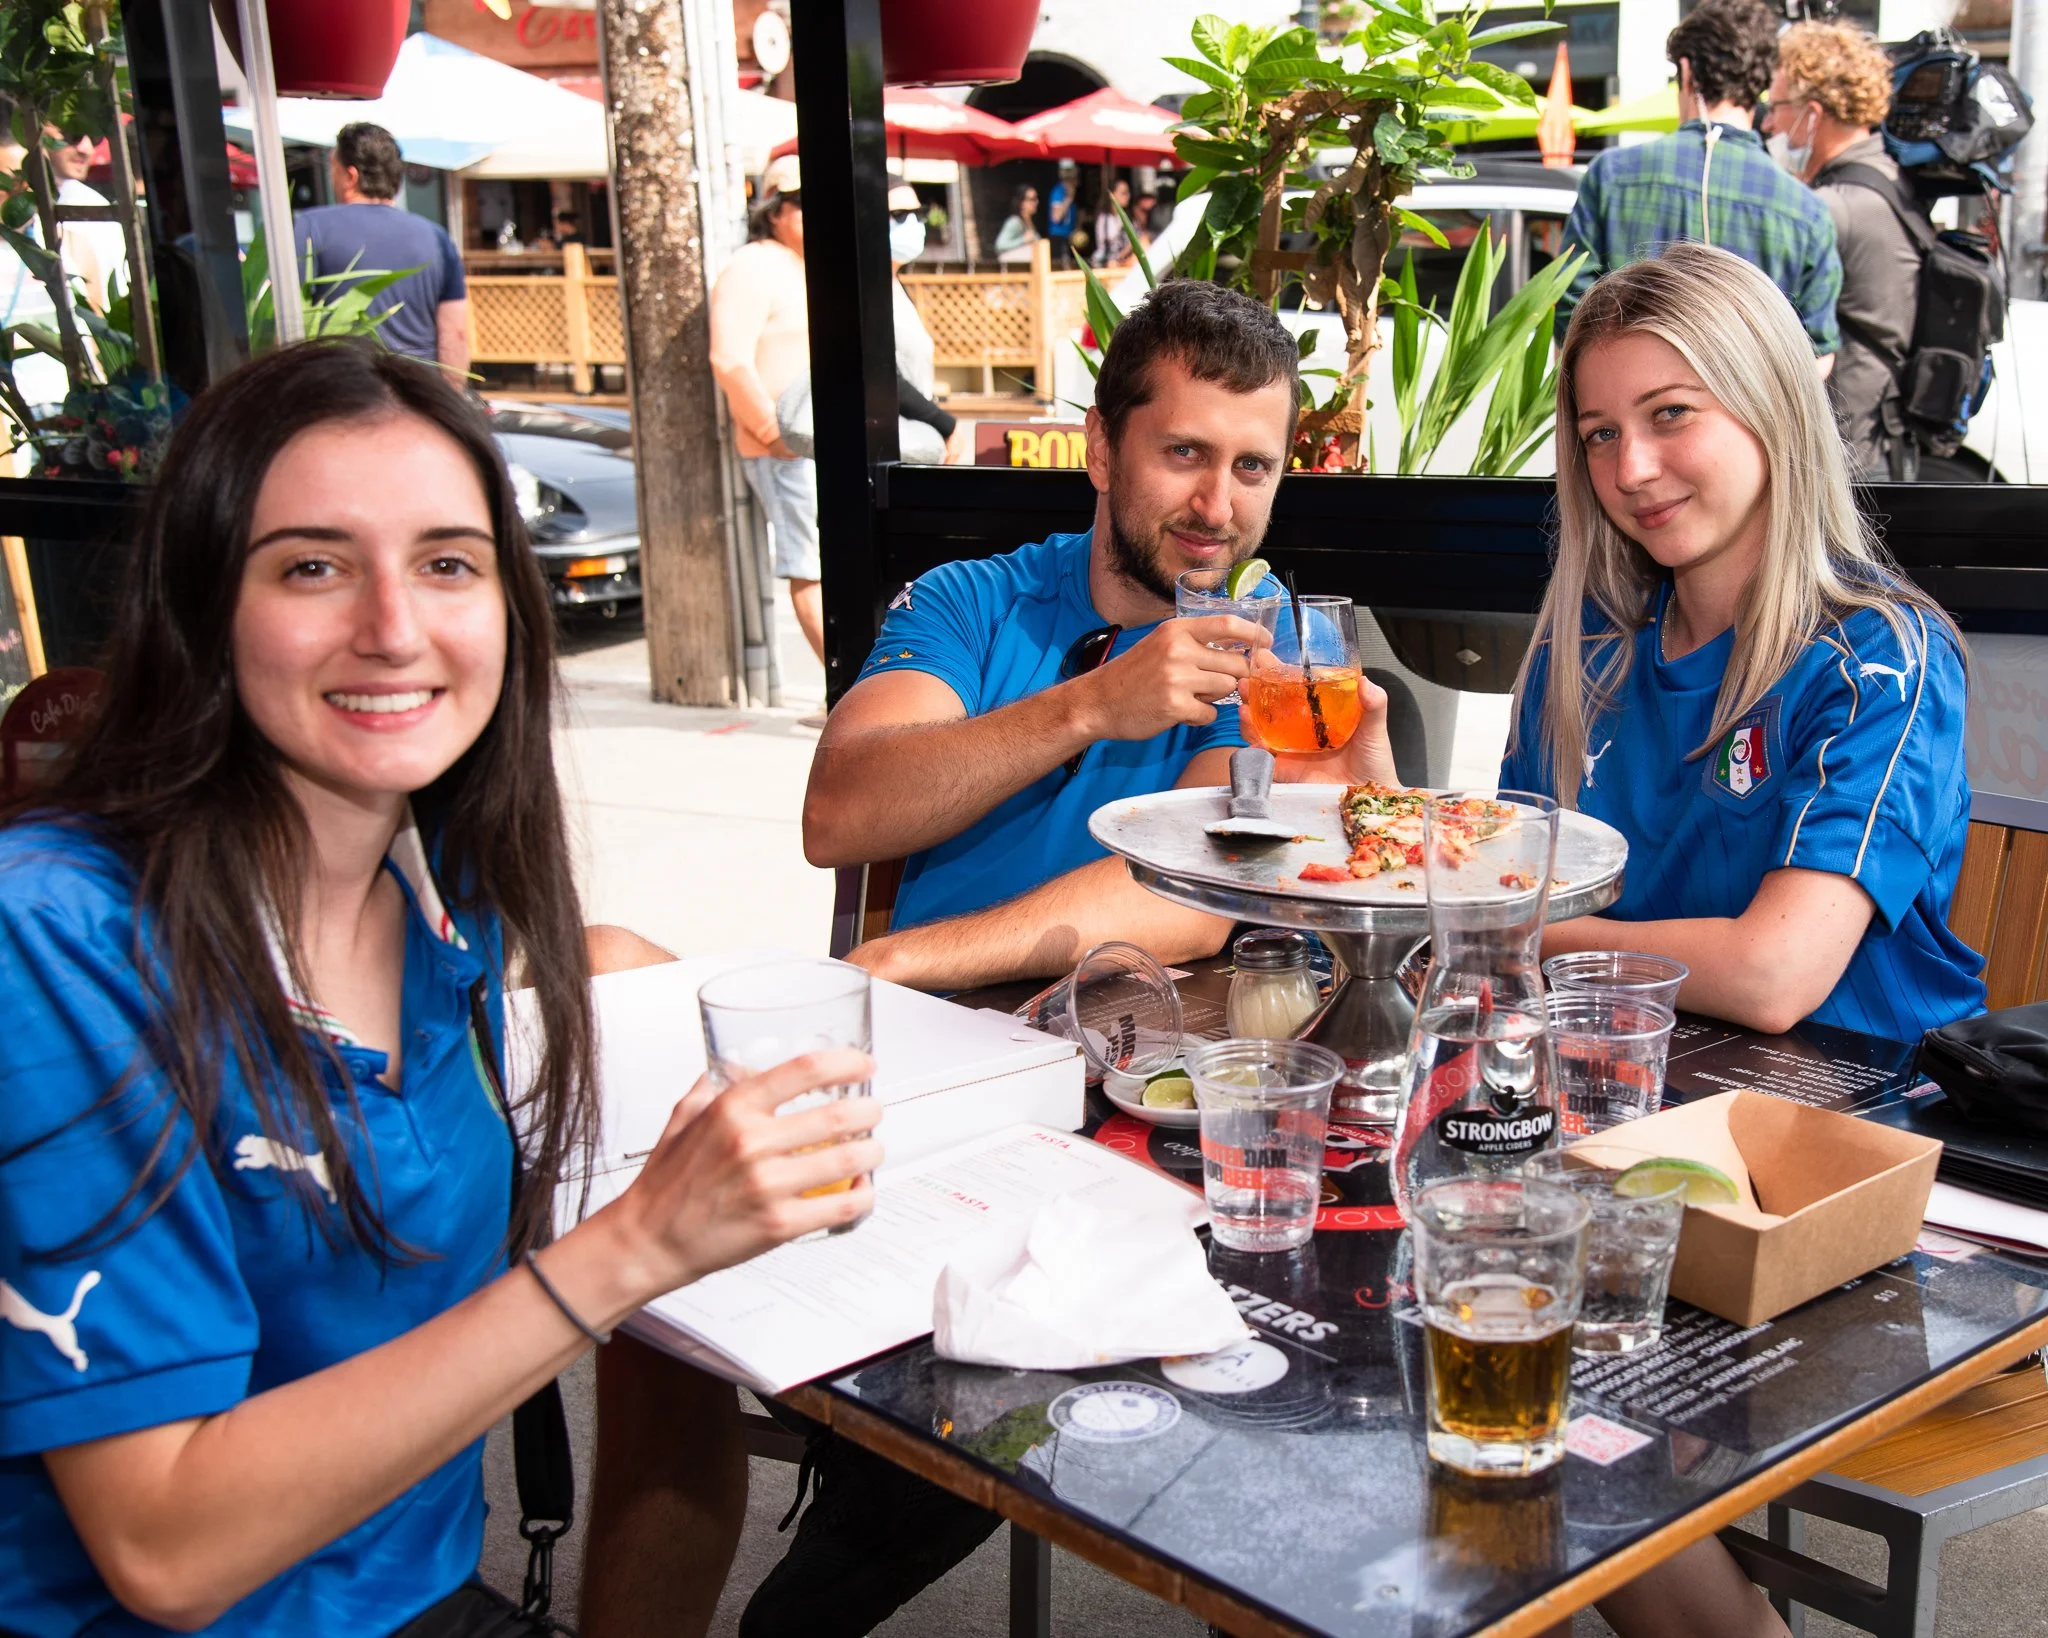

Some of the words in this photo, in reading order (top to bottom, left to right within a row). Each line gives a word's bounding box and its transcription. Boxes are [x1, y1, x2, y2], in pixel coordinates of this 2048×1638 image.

[1754, 1080, 1785, 1092] Lager
[1798, 1070, 1868, 1091] IMPORTED
[1445, 1111, 1553, 1142] STRONGBOW
[1031, 1132, 1071, 1149] PASTA
[1478, 1143, 1503, 1152] APPLE
[1505, 1139, 1533, 1151] CIDERS
[950, 1191, 990, 1211] PASTA
